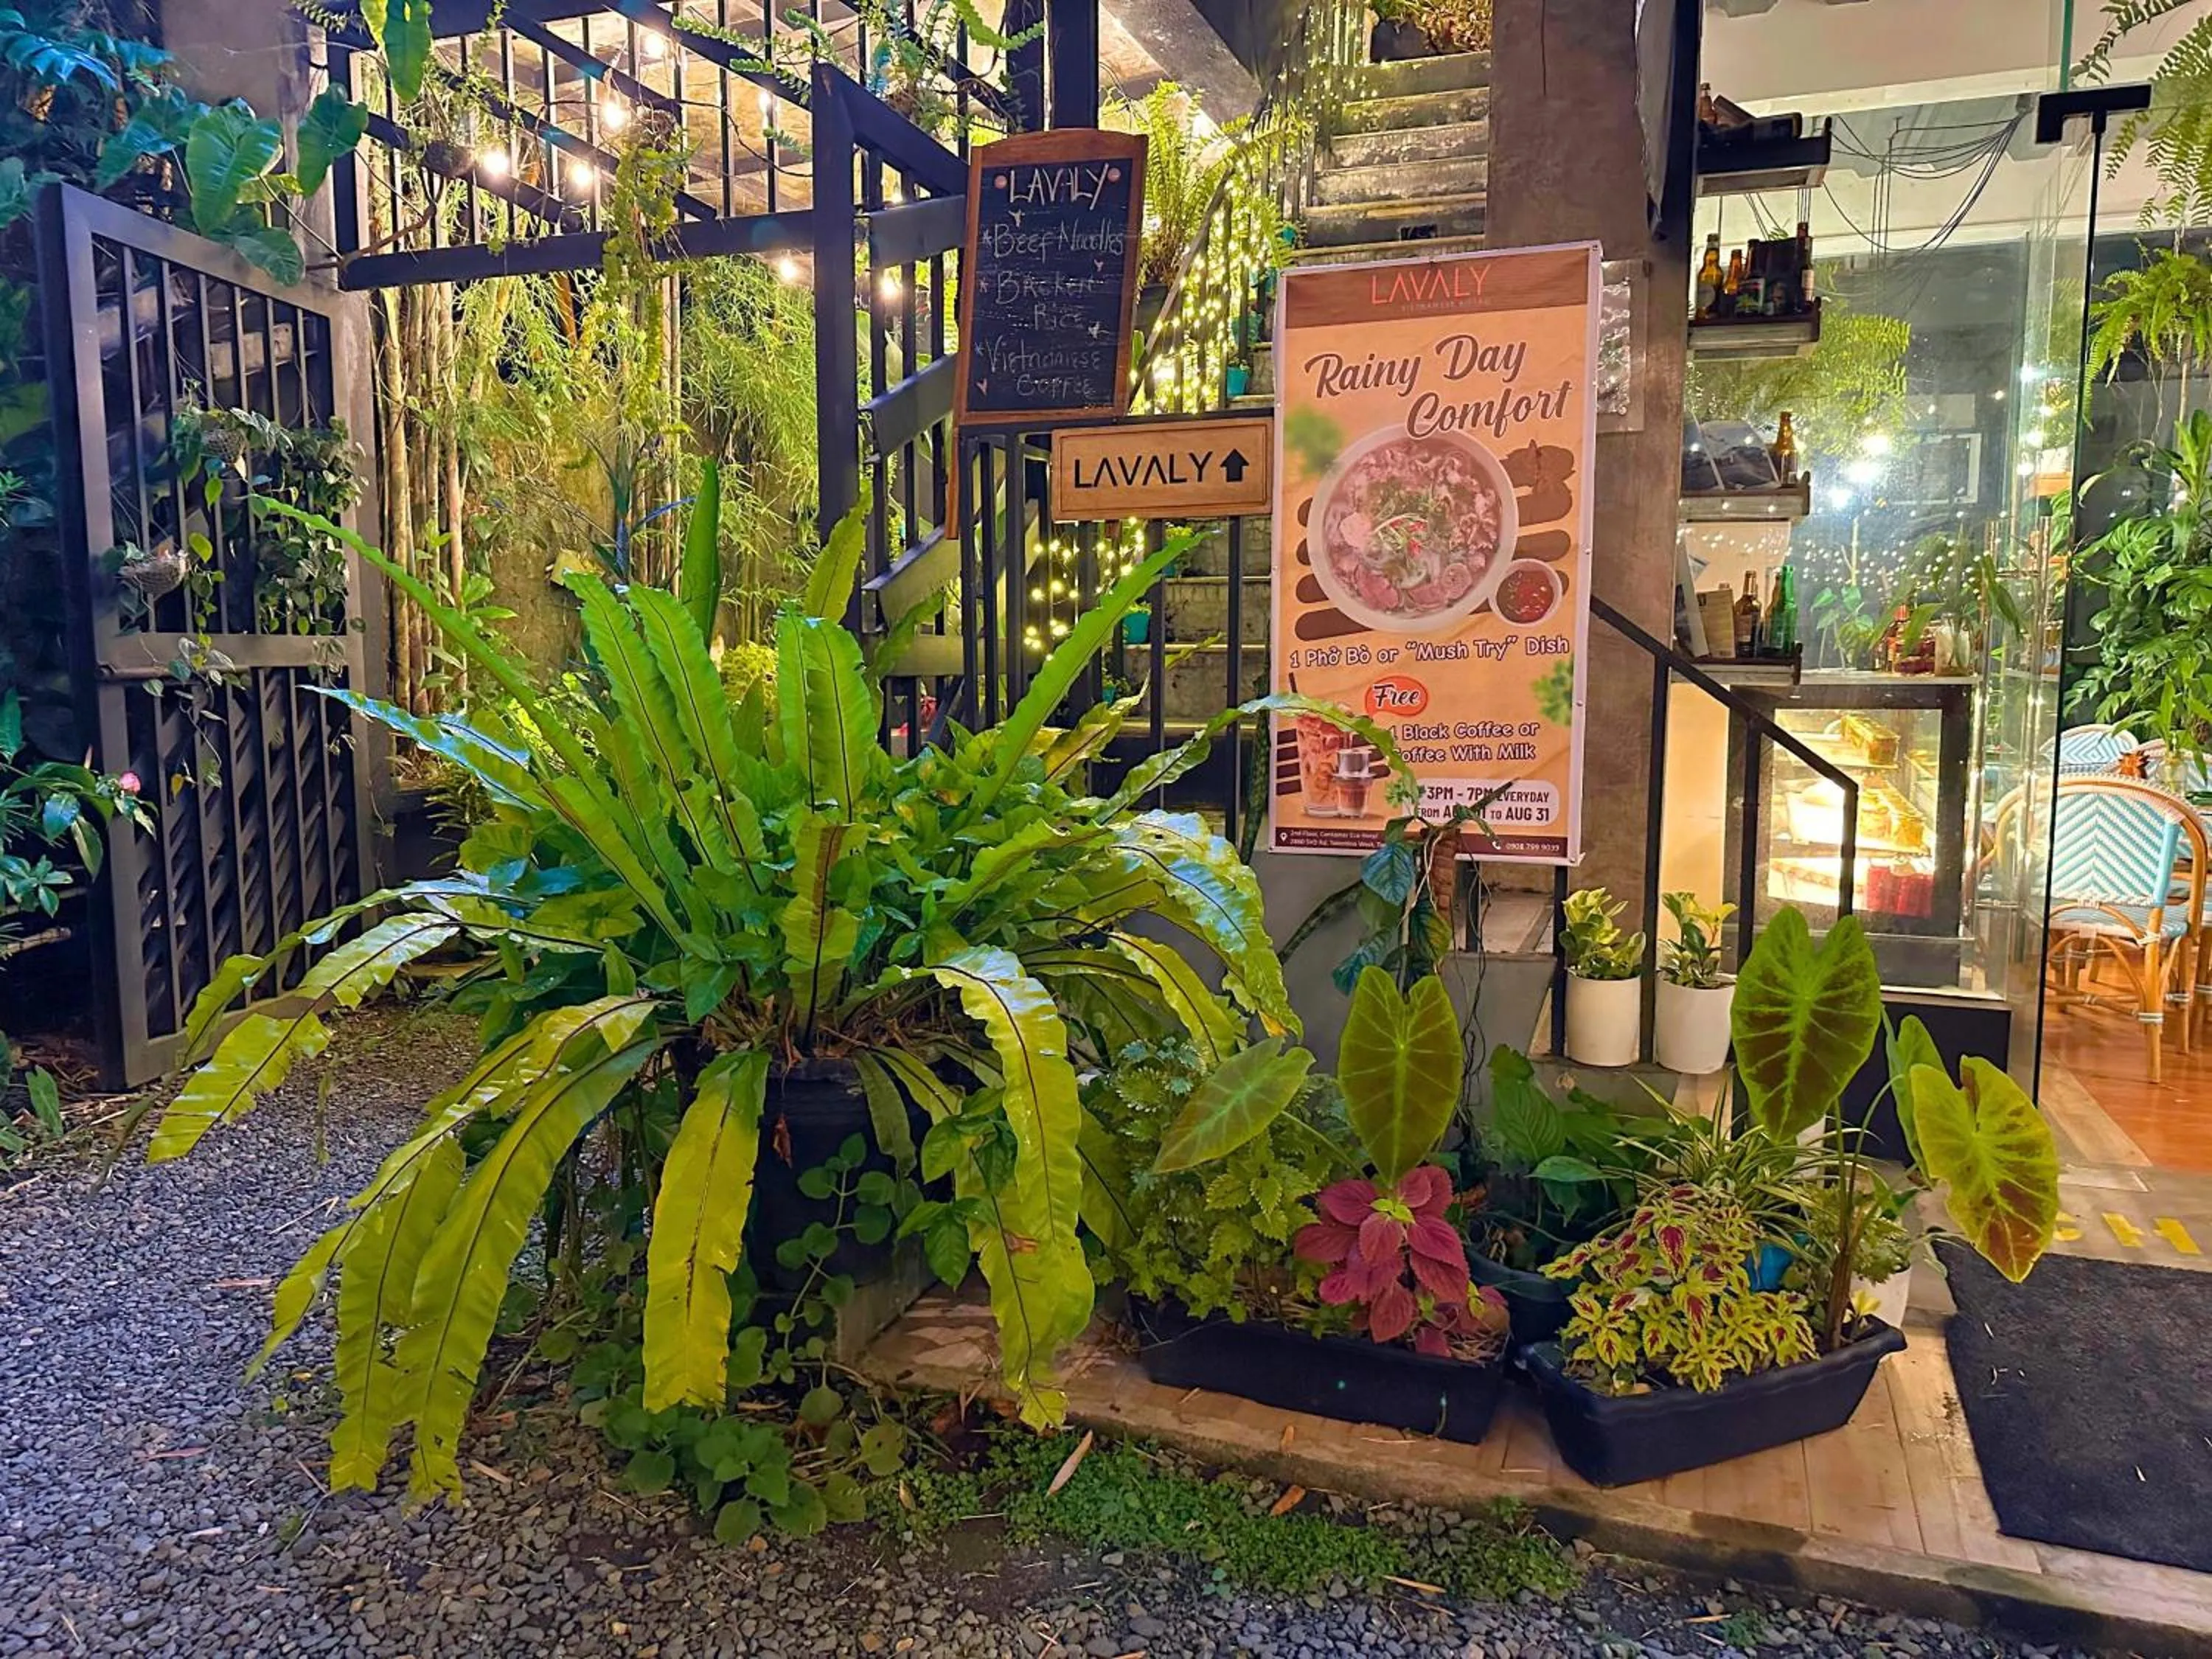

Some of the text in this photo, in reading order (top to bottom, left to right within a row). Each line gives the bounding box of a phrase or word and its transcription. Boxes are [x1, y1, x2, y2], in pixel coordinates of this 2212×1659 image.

[1009, 163, 1110, 211] LAVALY
[1371, 263, 1492, 305] LAVALY
[1304, 334, 1527, 399] Rainy Day
[1406, 380, 1573, 439] Comfort
[1074, 451, 1214, 490] LAVALY
[1290, 650, 1299, 668] 1
[1377, 648, 1399, 663] or
[1526, 636, 1570, 655] Dish
[1373, 683, 1421, 708] Free
[1402, 723, 1449, 740] Black
[1454, 721, 1514, 738] Coffee
[1519, 722, 1540, 736] or
[1450, 744, 1492, 762] With
[1498, 742, 1536, 760] Milk
[1427, 787, 1453, 800] 3PM
[1491, 810, 1502, 820] TO
[1506, 808, 1532, 821] AUG
[1536, 808, 1549, 821] 31
